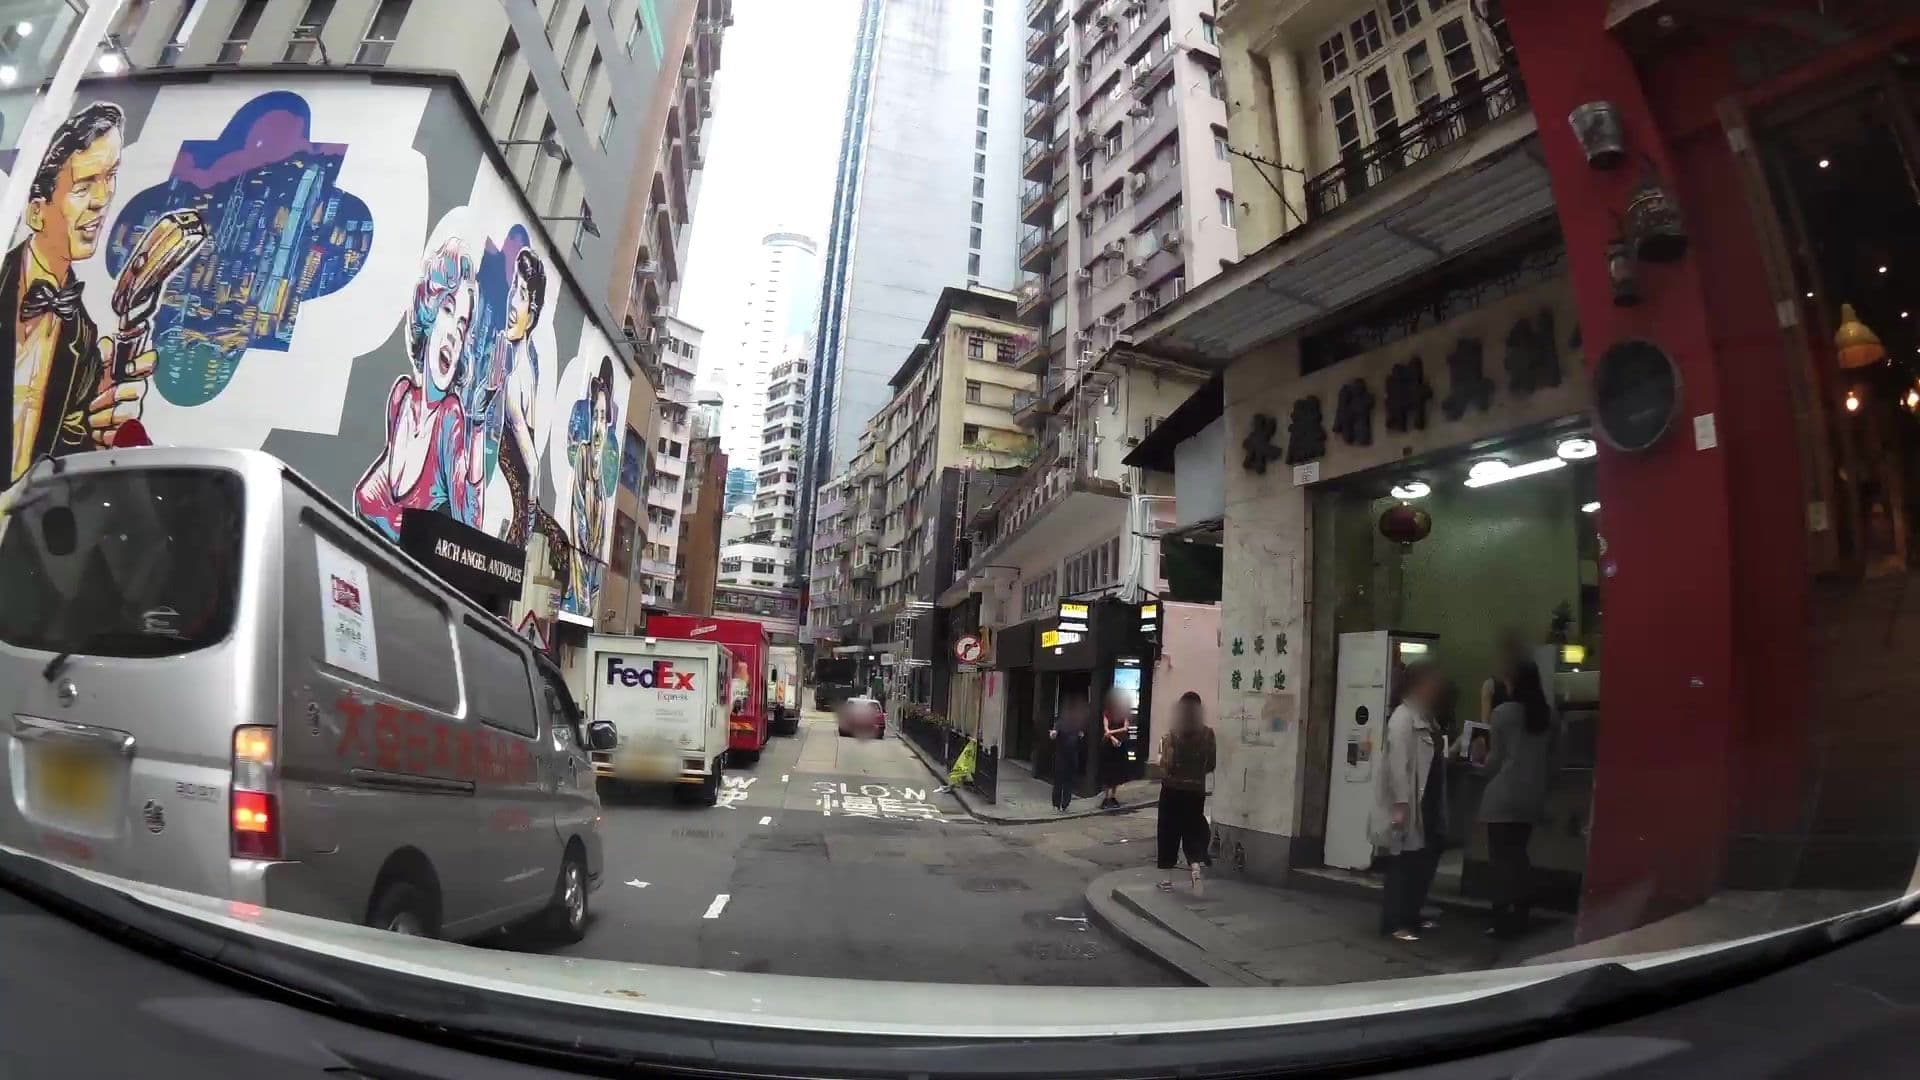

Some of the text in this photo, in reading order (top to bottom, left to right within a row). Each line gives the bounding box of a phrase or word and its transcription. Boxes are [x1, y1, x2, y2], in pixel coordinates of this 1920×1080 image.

[435, 538, 523, 584] ARCH ANGEL ANTIQUES
[606, 657, 695, 691] FedEx
[811, 781, 926, 800] SLOW
